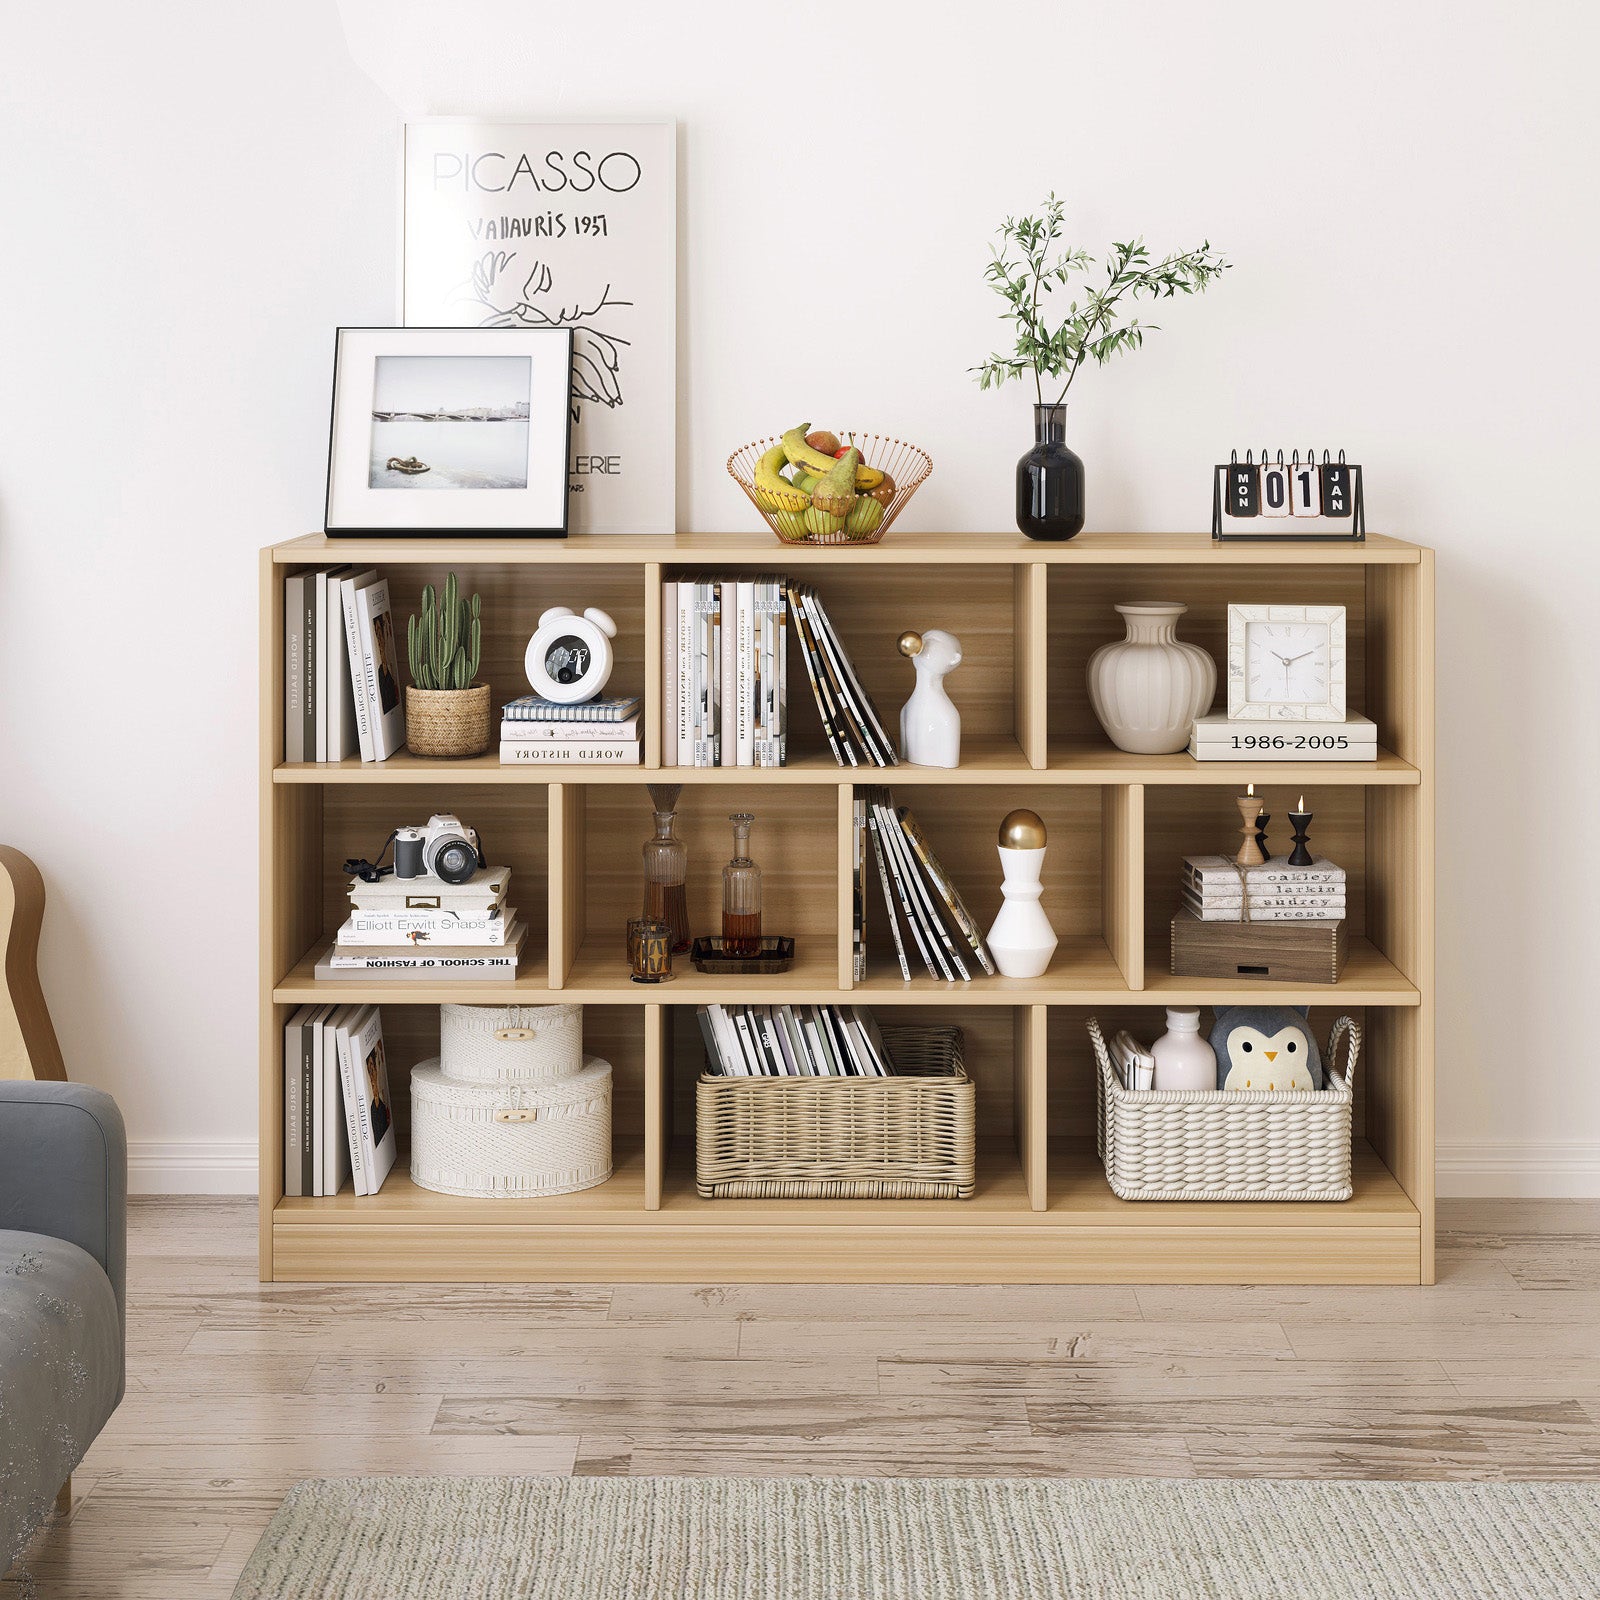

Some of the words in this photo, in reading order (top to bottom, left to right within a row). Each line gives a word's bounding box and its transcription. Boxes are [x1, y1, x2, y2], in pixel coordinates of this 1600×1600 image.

[433, 151, 641, 193] PICASSO
[1237, 473, 1249, 507] MON
[1330, 471, 1343, 511] JAN
[1231, 735, 1349, 750] 1986-2005
[1267, 873, 1333, 882] oakley
[1276, 886, 1336, 894] larkin
[1263, 898, 1331, 907] audrey
[1273, 910, 1326, 918] reese
[356, 920, 393, 930] Elliott
[398, 919, 436, 930] Erwitt
[441, 919, 486, 931] Snaps
[761, 1032, 771, 1048] GAB
